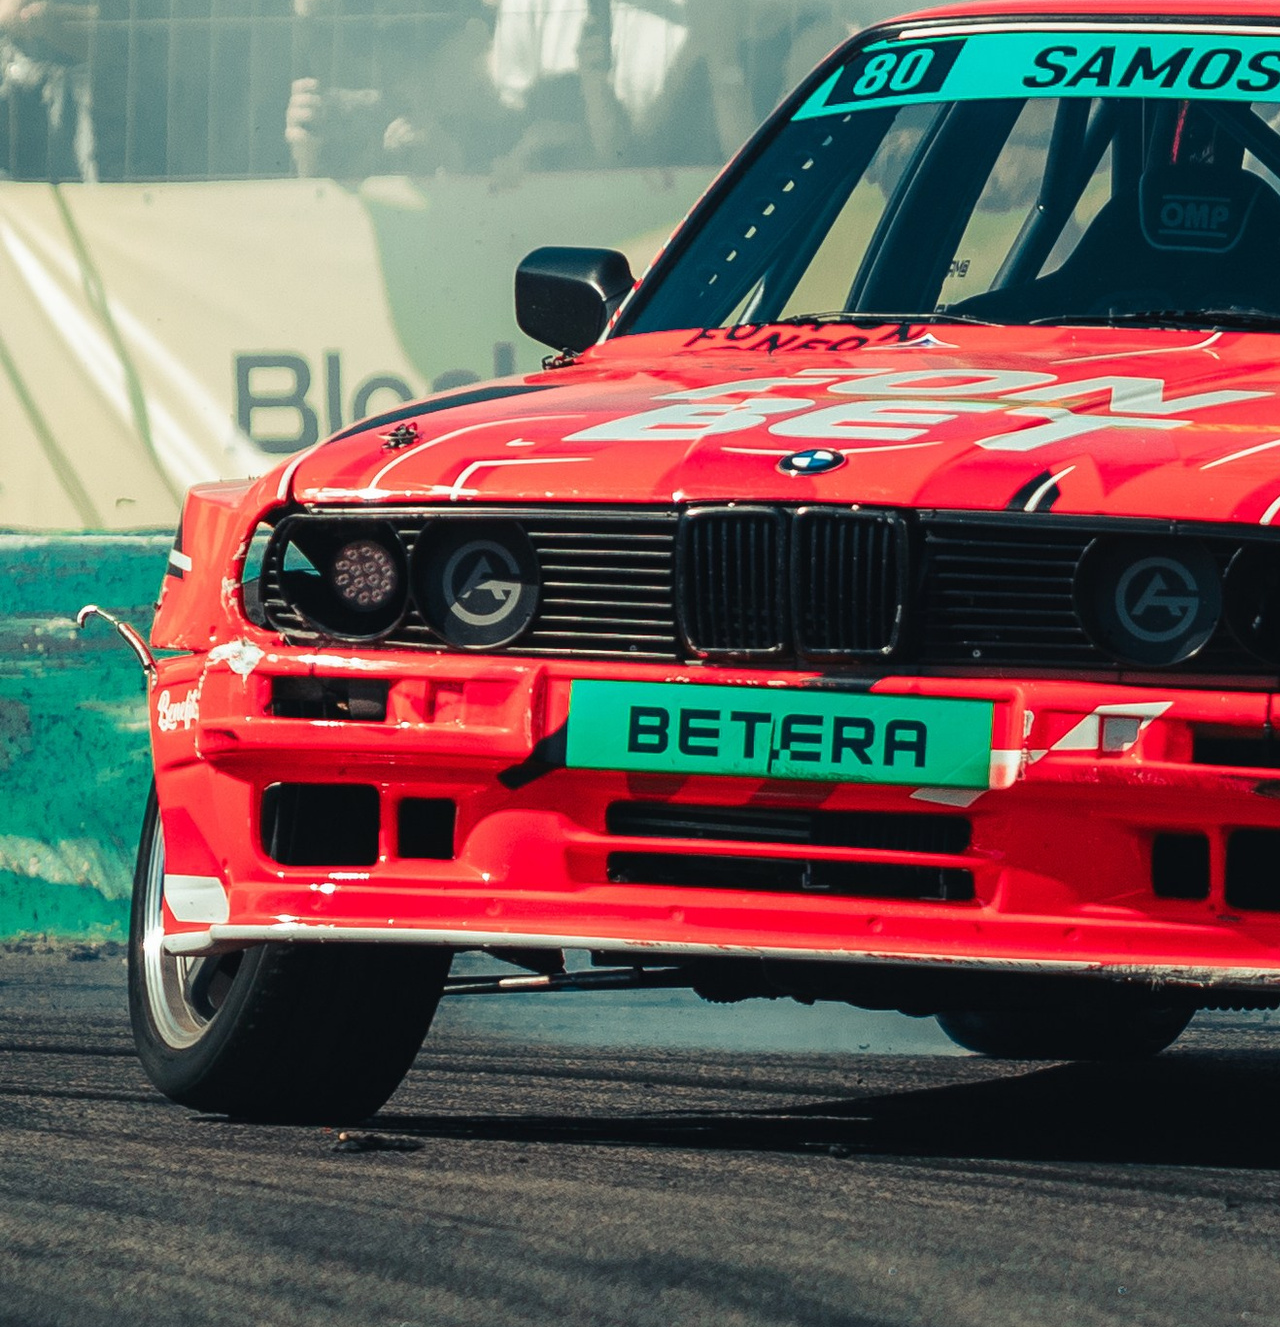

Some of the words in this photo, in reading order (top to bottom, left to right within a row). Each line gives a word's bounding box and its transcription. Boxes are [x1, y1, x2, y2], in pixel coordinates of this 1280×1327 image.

[853, 48, 935, 96] 80
[1161, 201, 1230, 229] OMP
[562, 398, 1194, 452] BET
